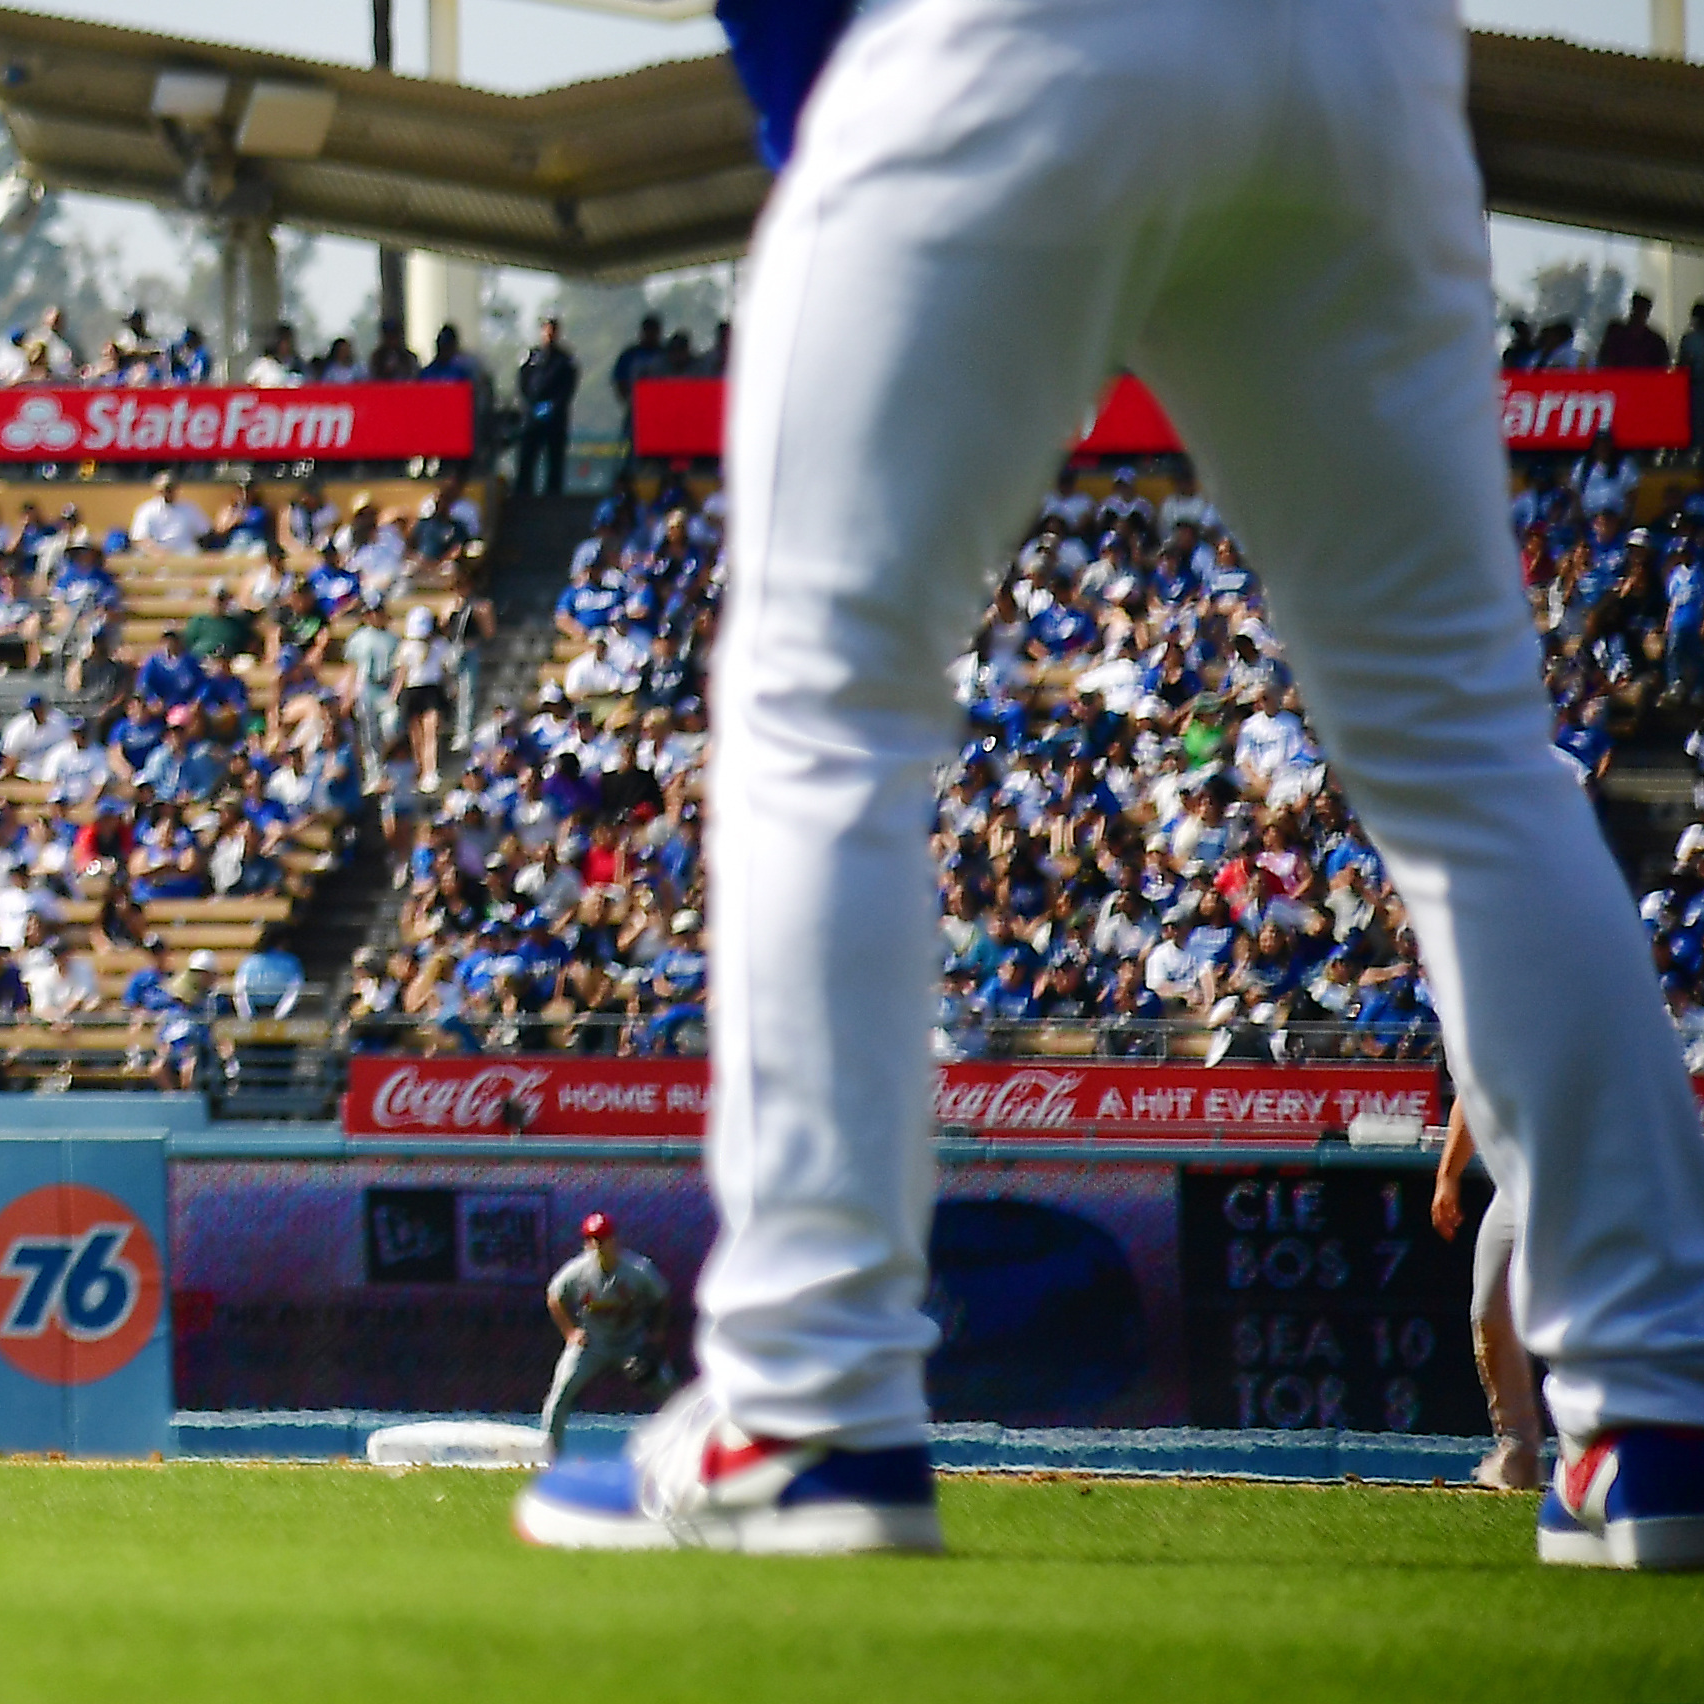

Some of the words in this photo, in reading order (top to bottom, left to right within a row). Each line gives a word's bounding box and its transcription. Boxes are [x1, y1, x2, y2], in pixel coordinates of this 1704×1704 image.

[558, 1082, 662, 1114] HOME
[1096, 1088, 1129, 1122] A
[1132, 1086, 1196, 1120] HIT
[1203, 1086, 1326, 1123] EVERY
[1334, 1089, 1431, 1119] TIME
[1222, 1179, 1327, 1233] CLE
[1380, 1179, 1403, 1233] 1
[1227, 1237, 1351, 1290] BOS
[1372, 1239, 1413, 1290] 7
[1232, 1314, 1344, 1367] SEA
[1371, 1316, 1438, 1370] 10
[1234, 1373, 1351, 1430] TOR
